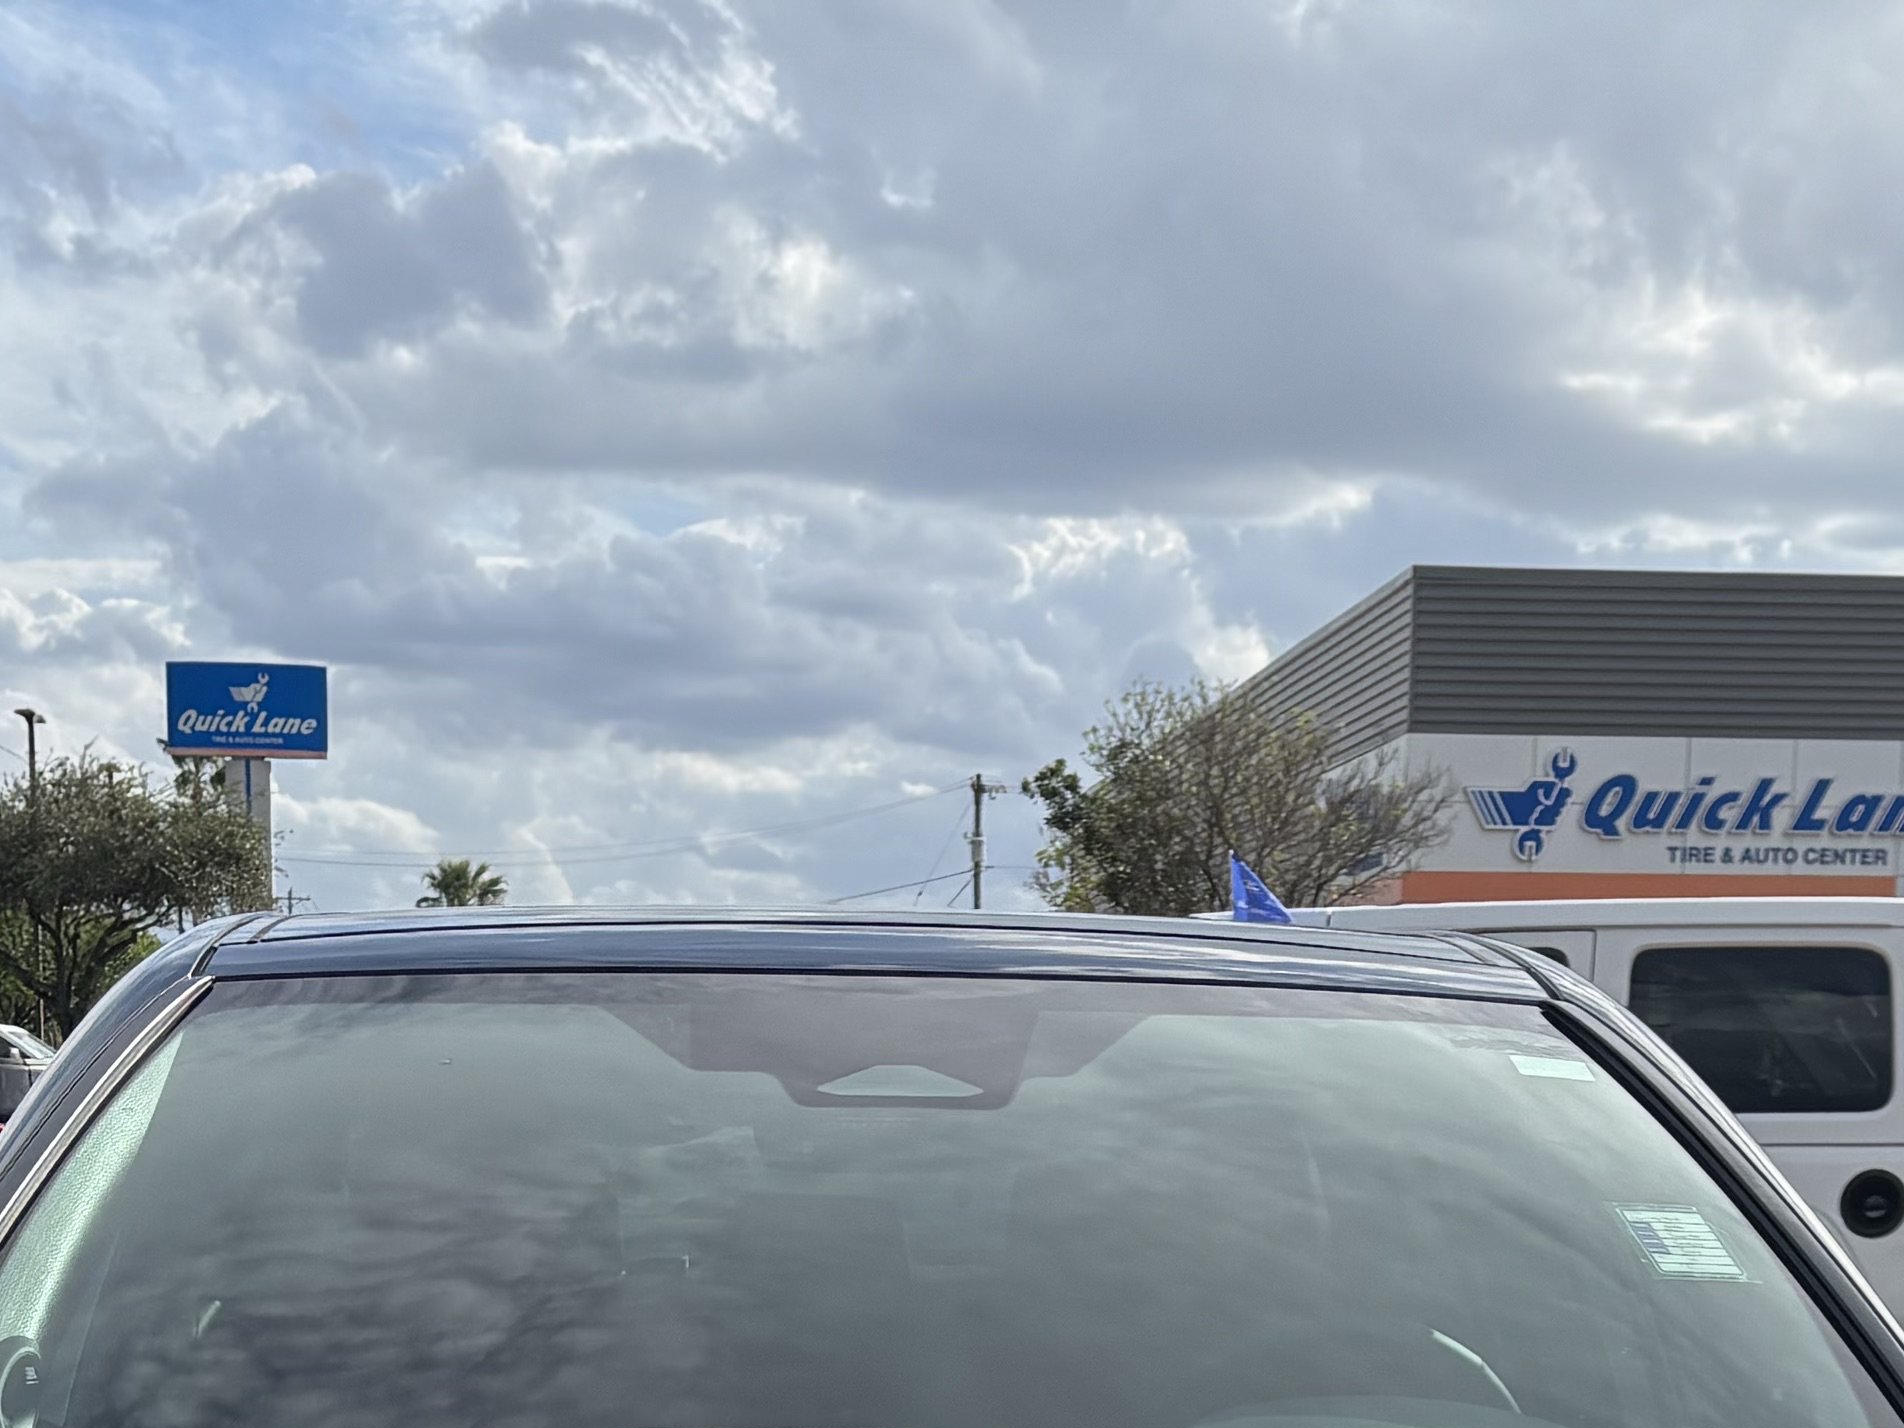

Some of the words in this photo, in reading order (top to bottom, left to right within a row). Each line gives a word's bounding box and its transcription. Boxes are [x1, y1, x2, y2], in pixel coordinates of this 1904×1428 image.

[177, 708, 250, 734] Quick
[251, 710, 318, 735] Lane
[1583, 773, 1790, 841] Quick
[1665, 846, 1716, 864] TIRE
[1720, 847, 1735, 864] &
[1739, 847, 1799, 865] AUTO
[1802, 848, 1888, 866] CENTER
